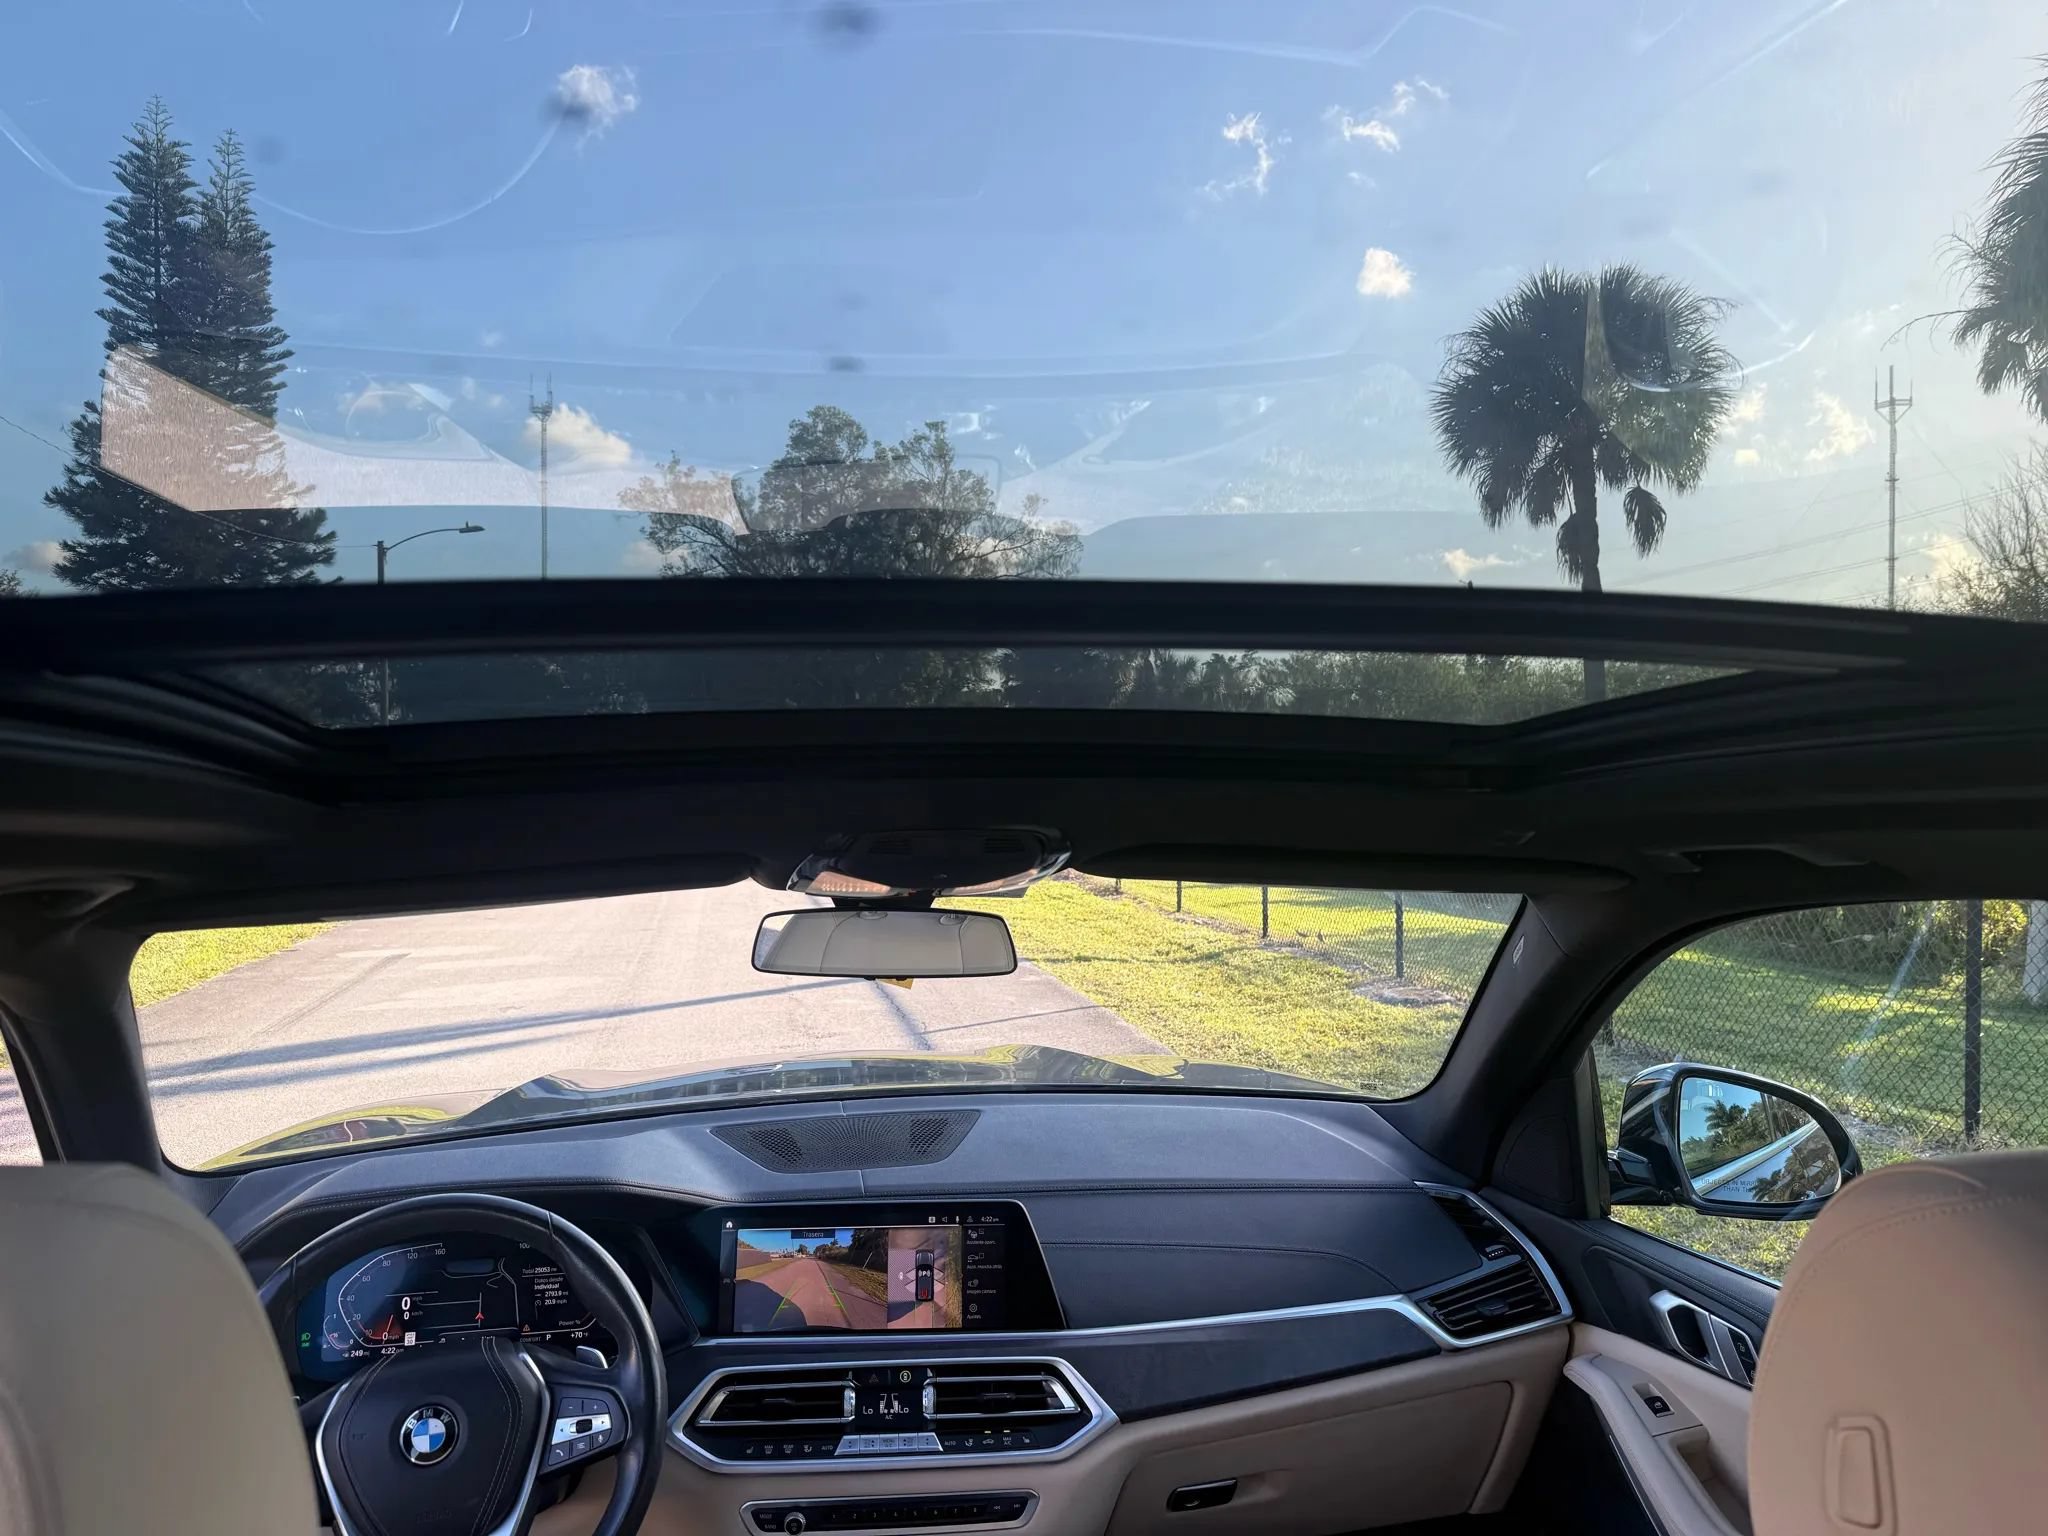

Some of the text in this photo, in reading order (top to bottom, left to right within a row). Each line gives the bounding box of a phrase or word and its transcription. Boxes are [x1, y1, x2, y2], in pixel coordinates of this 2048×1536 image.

[407, 1252, 418, 1260] 120
[401, 1296, 411, 1311] 0
[403, 1311, 410, 1320] 0
[382, 1332, 389, 1340] 0
[570, 1331, 583, 1339] +70
[862, 1405, 874, 1415] Lo
[898, 1404, 910, 1414] Lo
[406, 1408, 452, 1430] BMW
